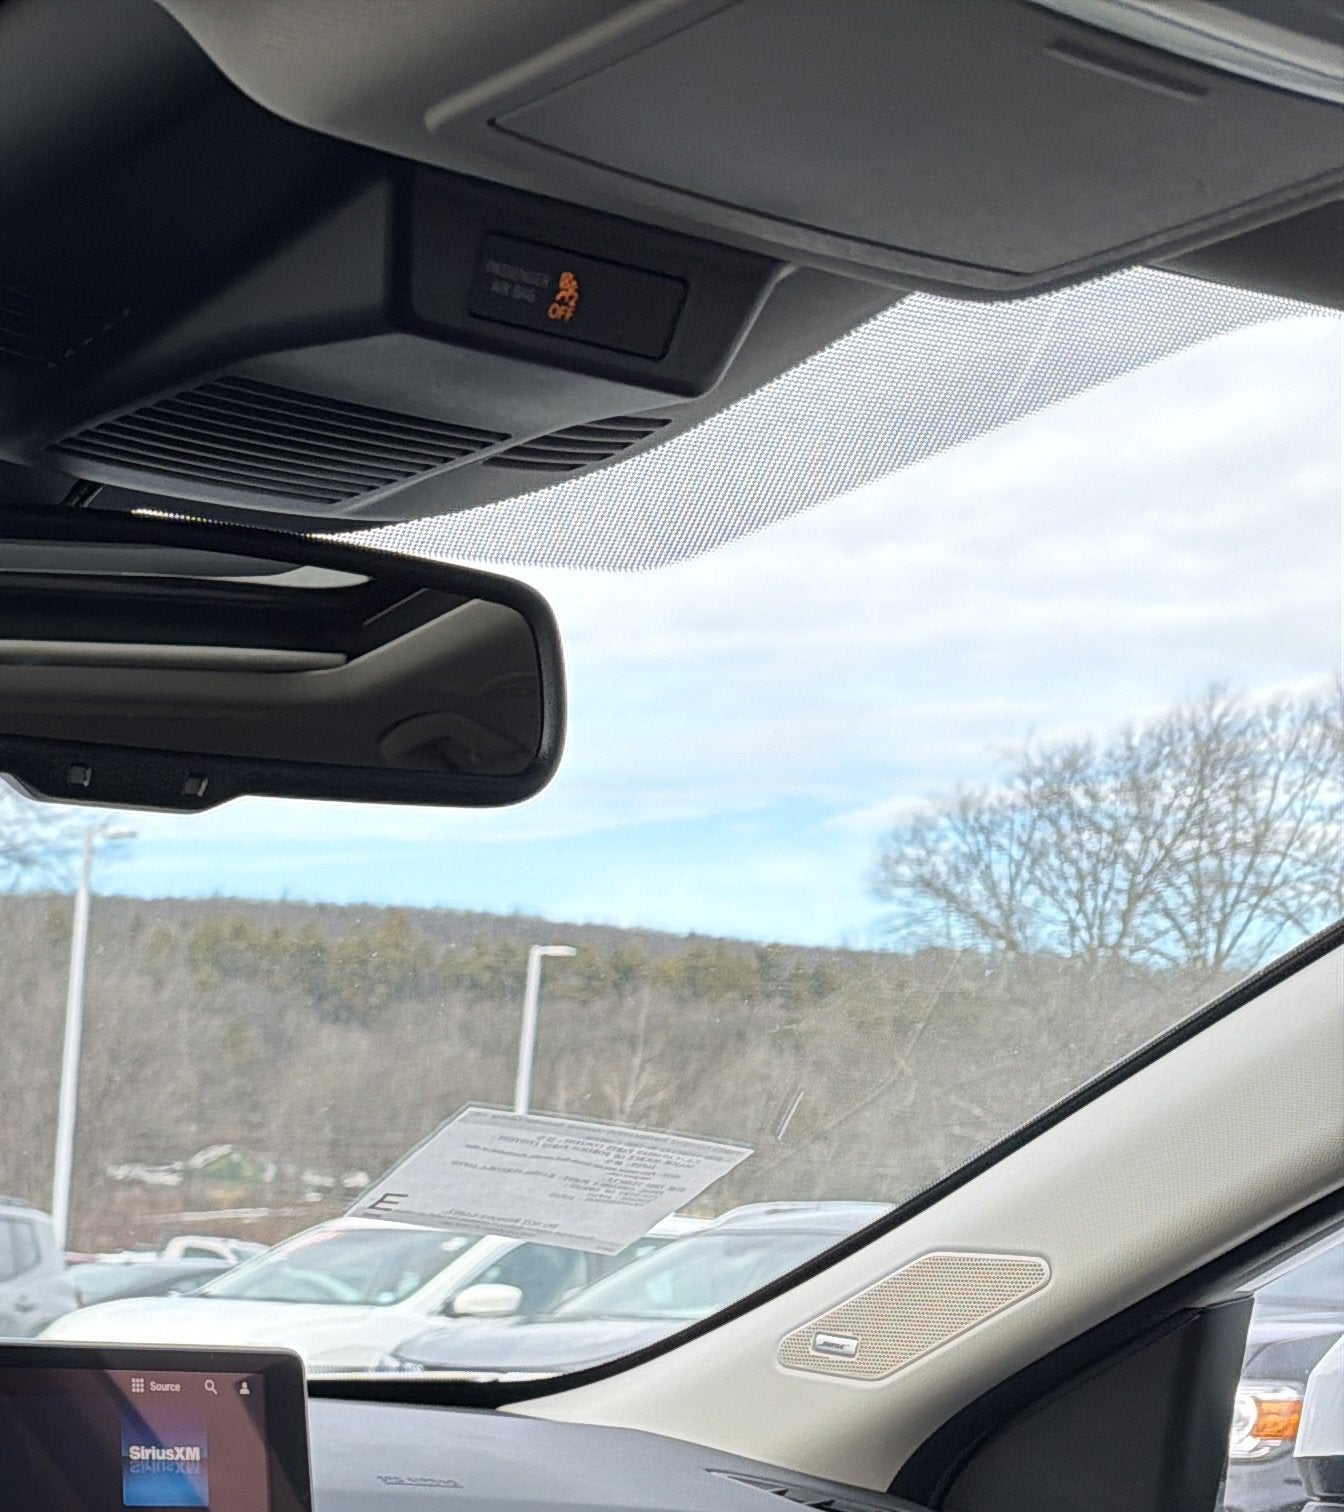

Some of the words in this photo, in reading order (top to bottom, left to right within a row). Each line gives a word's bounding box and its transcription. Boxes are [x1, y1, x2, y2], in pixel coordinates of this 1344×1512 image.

[548, 303, 574, 321] OFF
[149, 1381, 181, 1393] Source
[129, 1445, 201, 1461] SiriusXM
